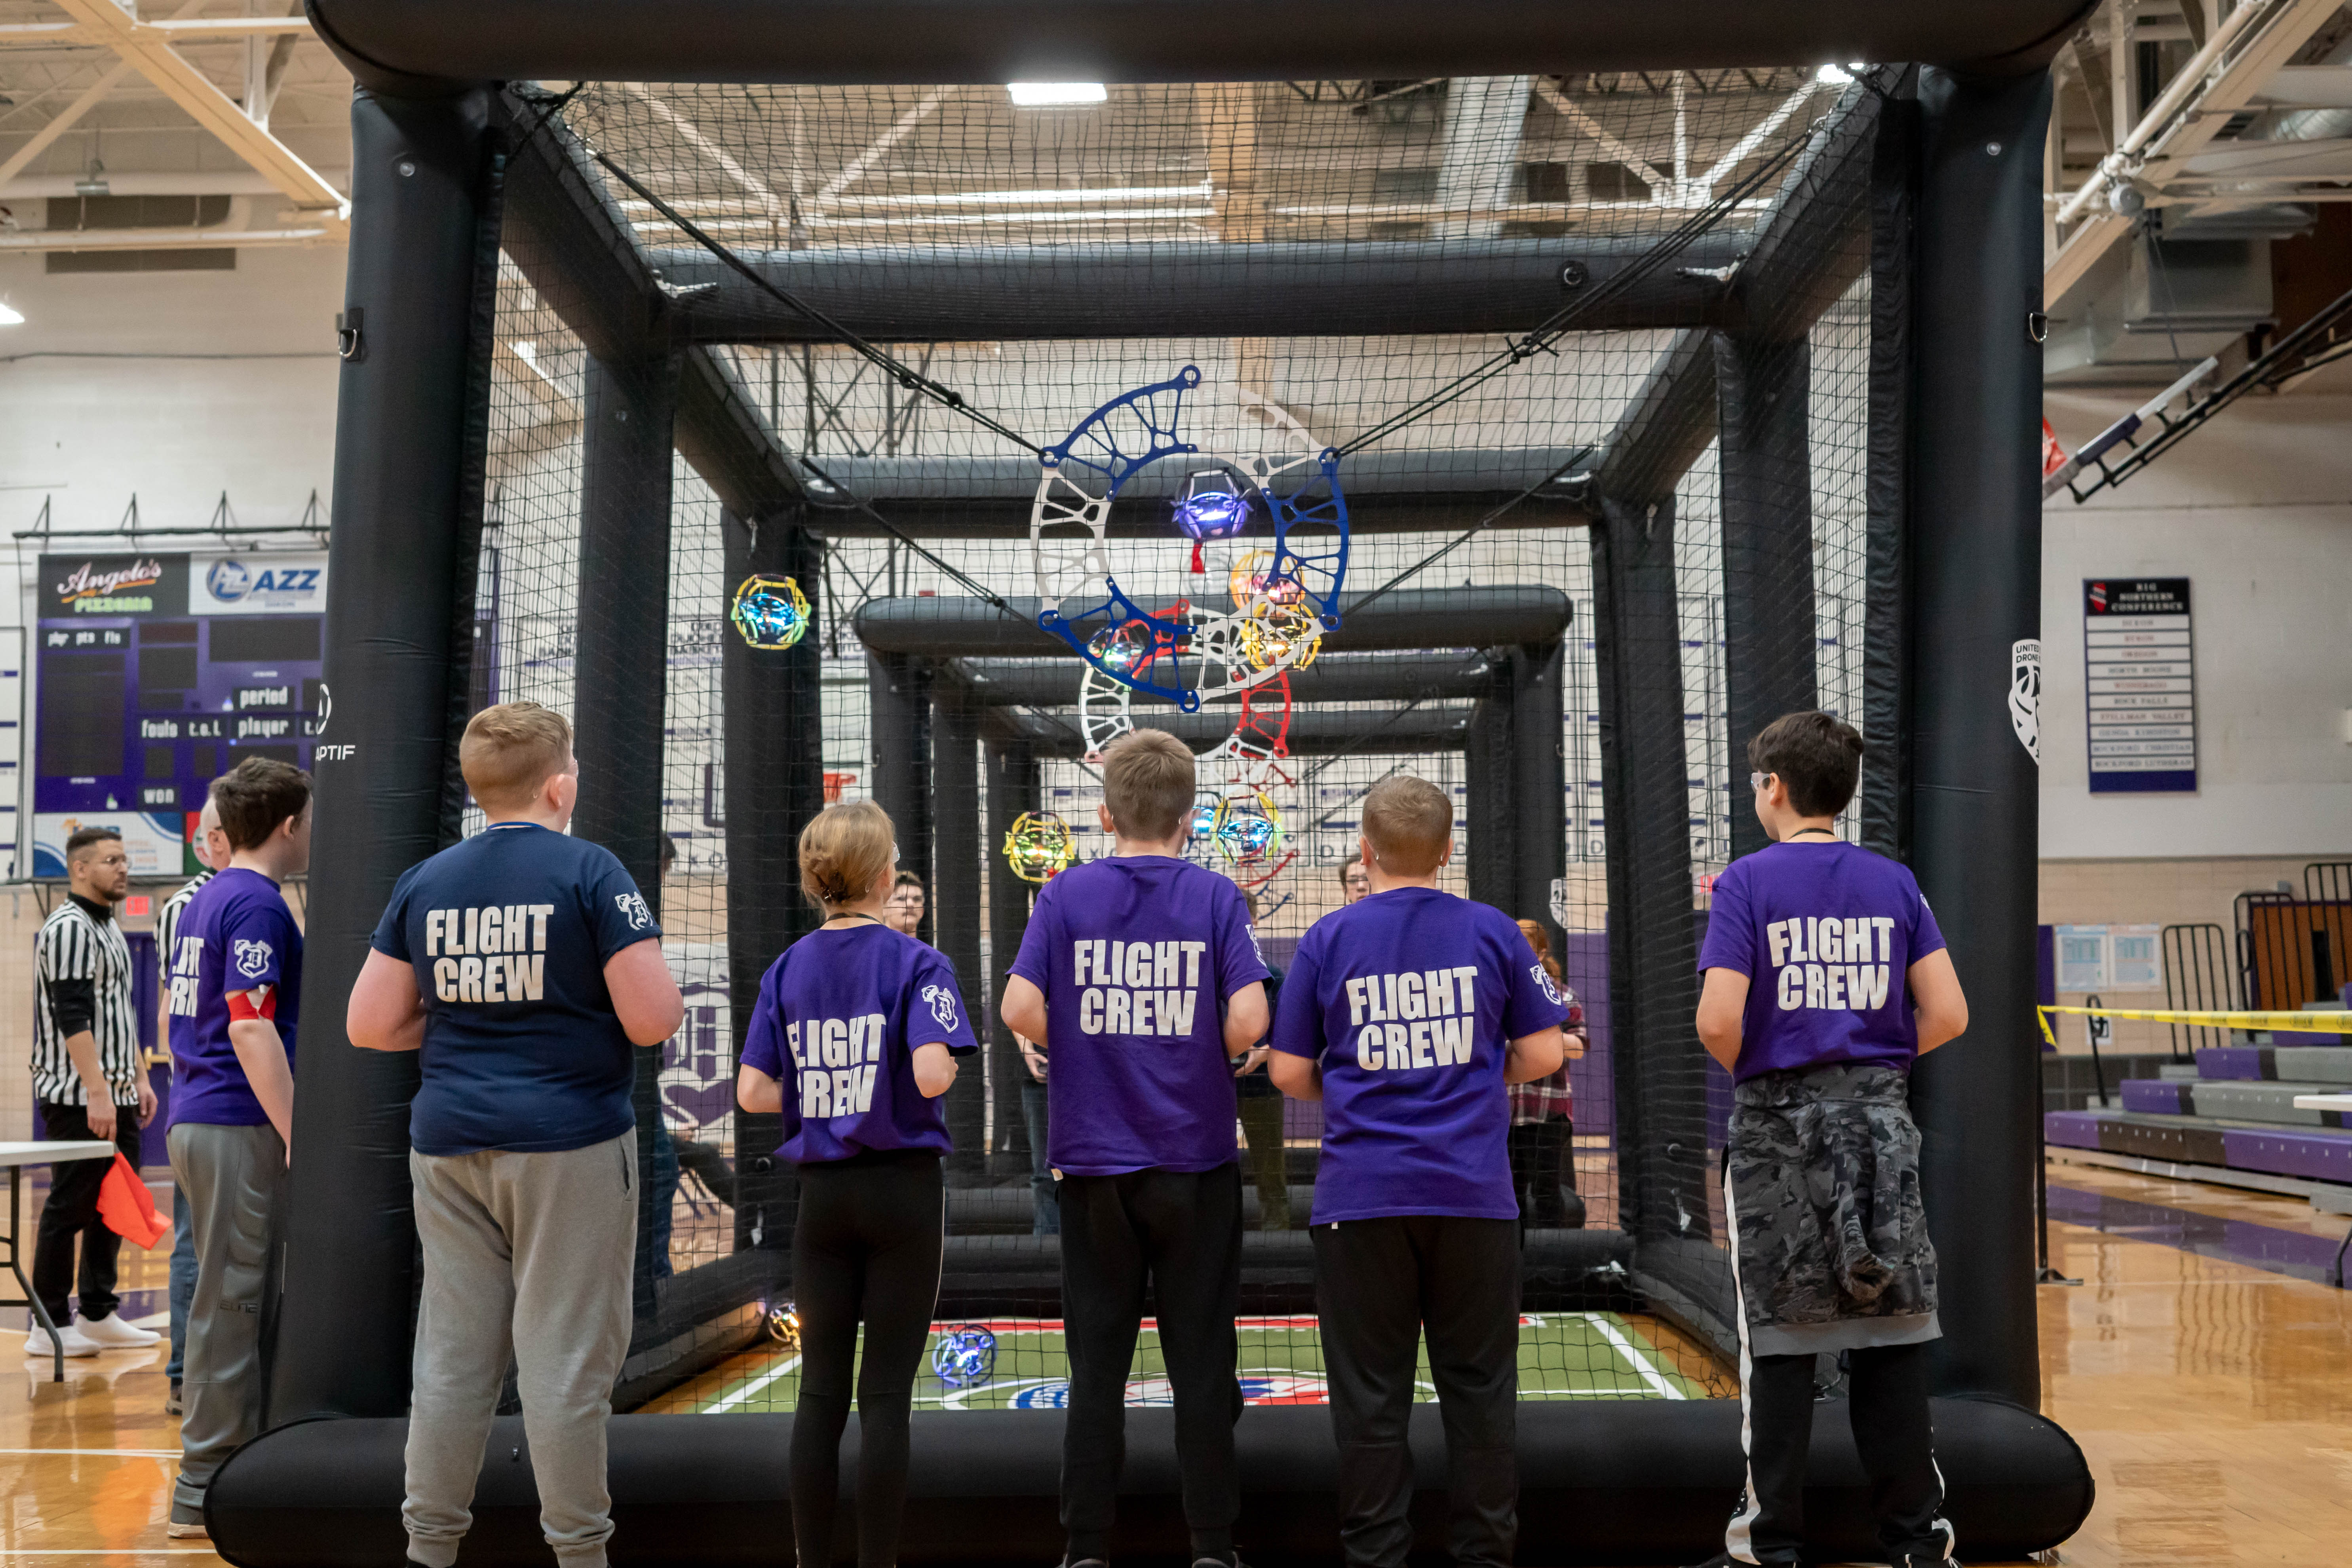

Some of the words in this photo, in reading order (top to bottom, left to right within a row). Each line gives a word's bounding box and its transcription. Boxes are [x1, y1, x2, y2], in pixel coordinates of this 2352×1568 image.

[57, 558, 162, 594] Angelo's
[253, 569, 321, 592] AZZ
[2136, 582, 2157, 592] BIG
[2111, 602, 2183, 612] CONFERENCE
[2016, 644, 2039, 654] UNITED
[2016, 653, 2038, 663] DRONE
[240, 686, 288, 709] period
[141, 719, 179, 738] fouls
[238, 716, 289, 739] player
[144, 789, 175, 804] won
[426, 904, 554, 956] FLIGHT
[1767, 917, 1894, 967] FLIGHT
[1074, 939, 1206, 988] FLIGHT
[434, 954, 545, 1003] CREW
[1778, 964, 1889, 1011] CREW
[1346, 966, 1478, 1026] FLIGHT
[1080, 988, 1196, 1036] CREW
[1358, 1016, 1474, 1071] CREW
